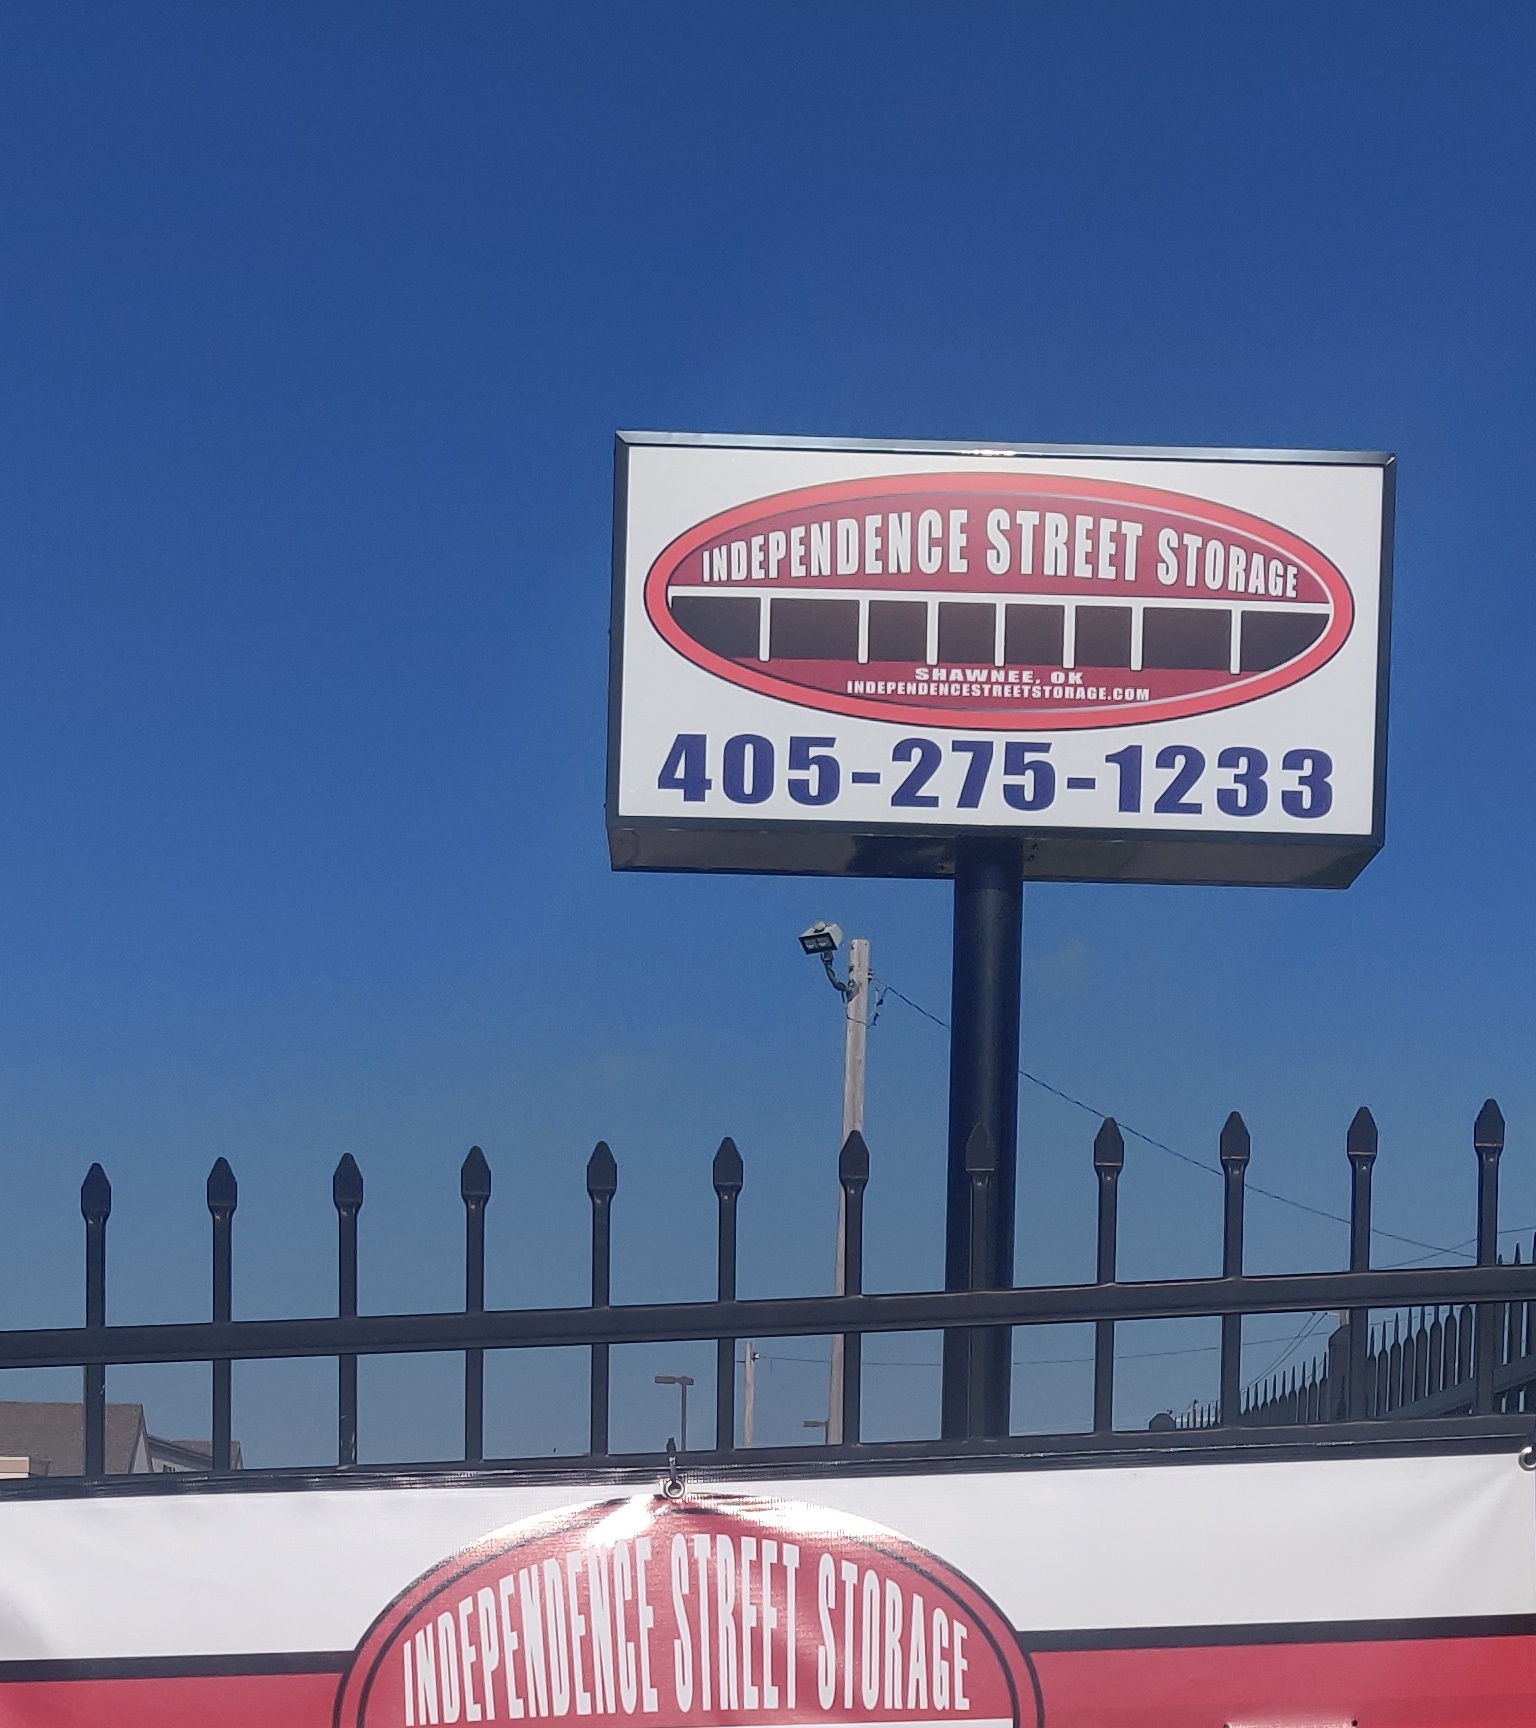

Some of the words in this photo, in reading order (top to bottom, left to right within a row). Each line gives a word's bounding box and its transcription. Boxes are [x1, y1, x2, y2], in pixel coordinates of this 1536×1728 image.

[702, 508, 969, 582] INDEPENDENCE
[984, 508, 1144, 582] STREET
[1156, 528, 1300, 598] STORAGE
[846, 679, 1151, 701] INDEPENDENCESTREETSTORAGE.COM
[914, 667, 1042, 685] SHAWNEE,
[1050, 671, 1084, 685] OK
[658, 733, 1333, 818] 405-275-1233
[402, 1537, 658, 1727] INDEPENDENCE
[671, 1533, 801, 1713] STREET
[818, 1552, 971, 1711] STORAGE
